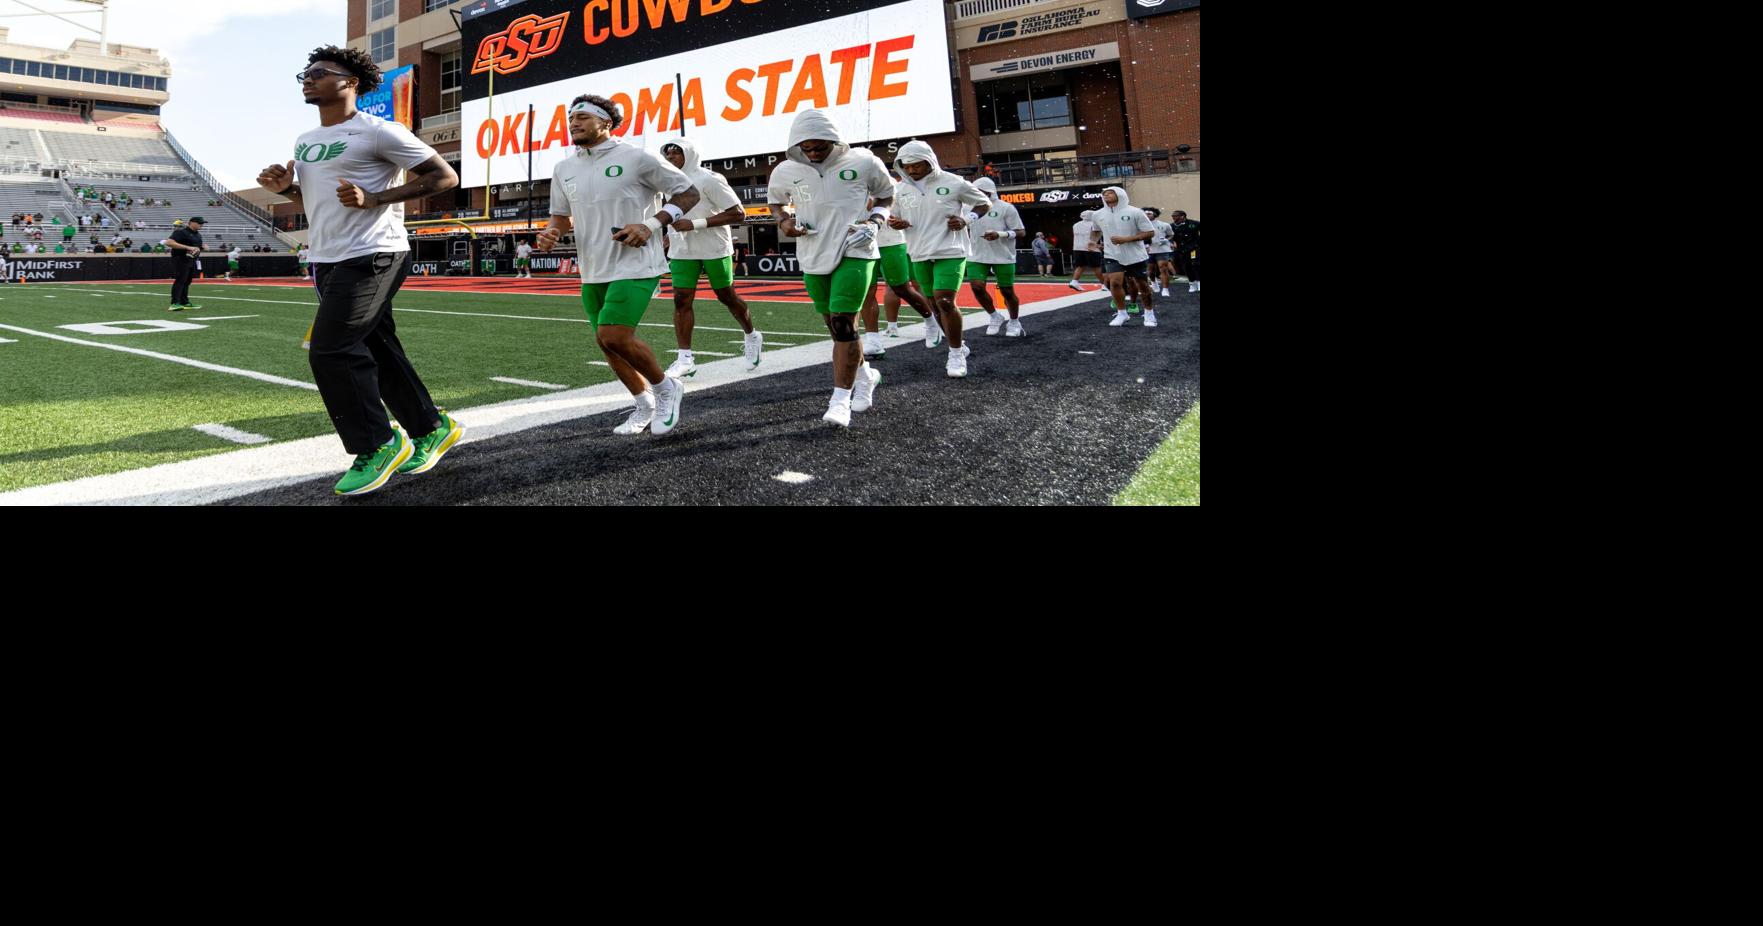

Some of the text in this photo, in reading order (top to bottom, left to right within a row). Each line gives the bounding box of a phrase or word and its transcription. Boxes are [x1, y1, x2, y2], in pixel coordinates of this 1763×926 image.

[1021, 7, 1085, 24] OKLAHOMA
[1021, 9, 1100, 29] FARM BUREAU
[1020, 19, 1082, 35] INSURANCE
[1021, 49, 1096, 70] DEVON ENERGY
[373, 91, 391, 104] FOR
[476, 34, 915, 160] OKLAOMA STATE
[362, 103, 386, 115] TWO
[605, 165, 623, 177] O
[839, 169, 857, 181] O
[412, 263, 437, 274] OATH
[531, 257, 562, 269] NATIONA
[758, 257, 800, 272] OAT
